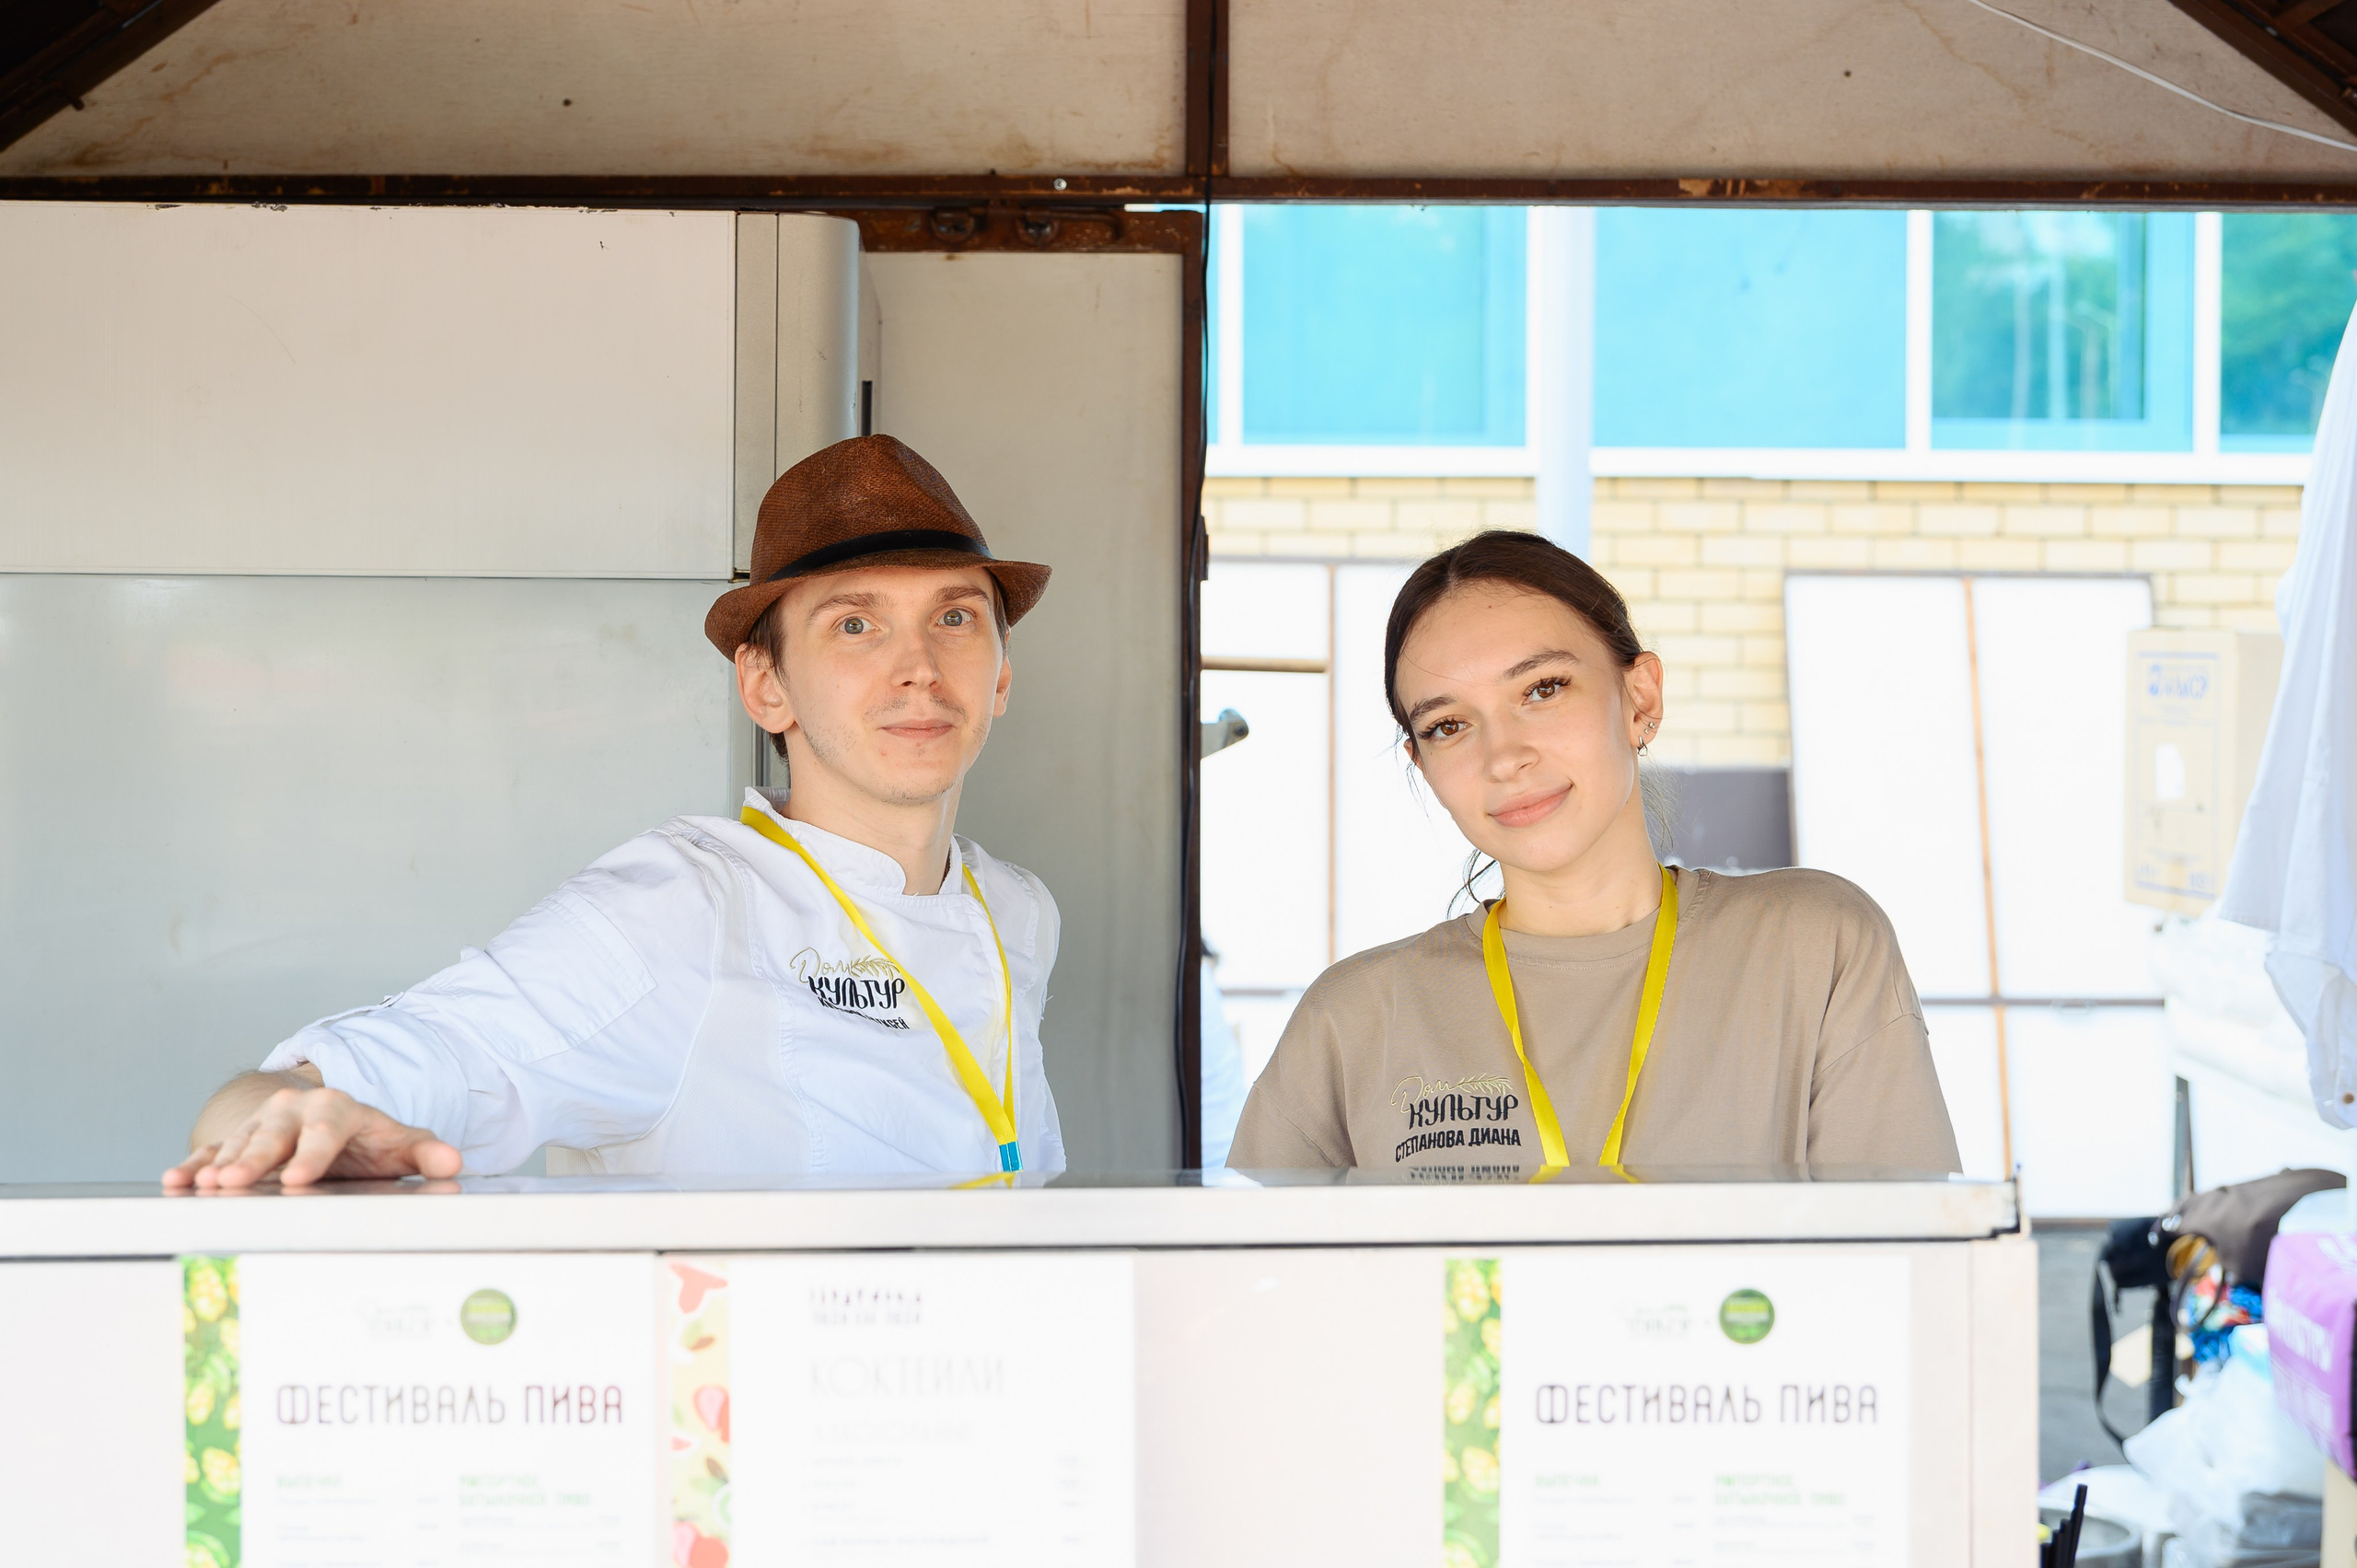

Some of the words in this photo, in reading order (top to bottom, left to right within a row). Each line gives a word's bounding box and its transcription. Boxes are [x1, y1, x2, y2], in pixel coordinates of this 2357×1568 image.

[808, 976, 906, 1010] КУЛЬТУР
[1409, 1093, 1519, 1130] КУЛЬТУР
[1395, 1129, 1465, 1163] СТЕПАНОВА
[1468, 1127, 1522, 1147] ДИАНА
[276, 1385, 505, 1425] ФЕСТИВАЛЬ
[524, 1385, 623, 1425] ПИВА
[1535, 1384, 1762, 1424] ФЕСТИВАЛЬ
[1779, 1384, 1878, 1424] ПИВА
